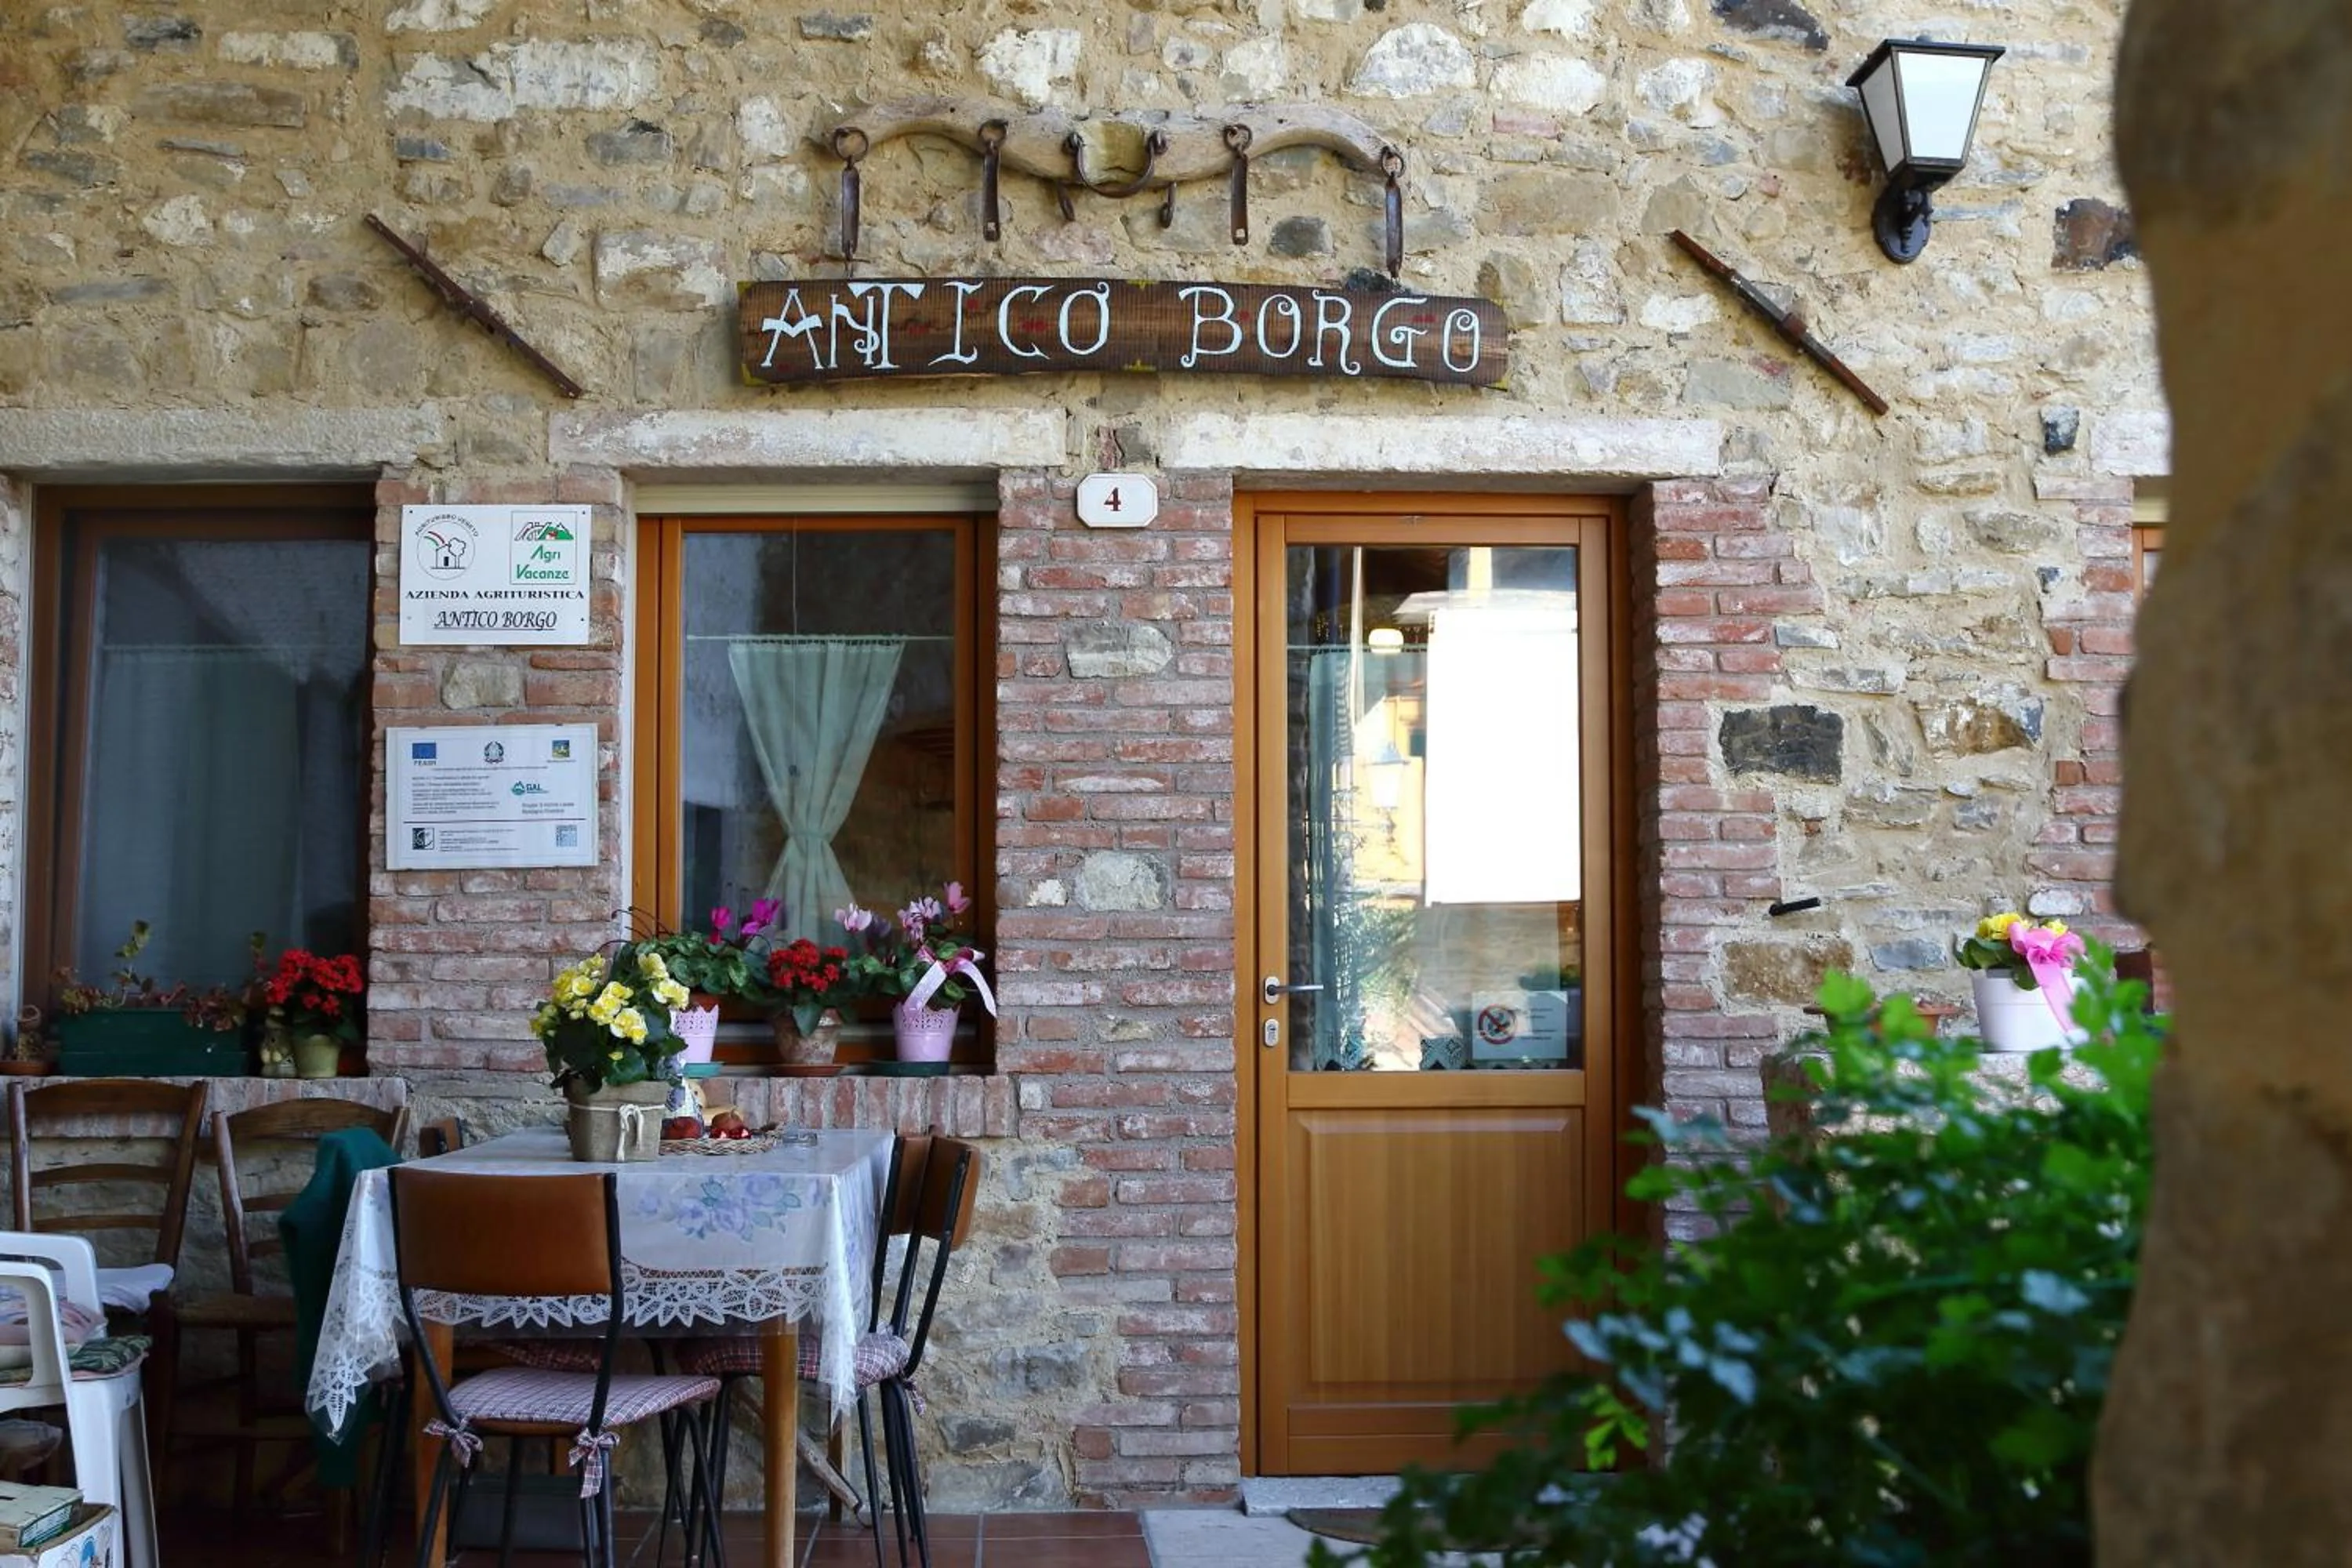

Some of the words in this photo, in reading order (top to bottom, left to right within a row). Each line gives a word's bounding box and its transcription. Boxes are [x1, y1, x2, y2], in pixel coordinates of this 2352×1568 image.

[760, 280, 1110, 371] ANTICO
[1179, 285, 1480, 376] BORGO
[1104, 487, 1122, 511] 4
[530, 544, 561, 563] Agri
[517, 564, 570, 579] Vacanze
[405, 590, 469, 600] AZIENDA
[474, 590, 584, 600] AGRITURISTICA
[434, 610, 499, 628] ANTICO
[502, 611, 557, 630] BORGO
